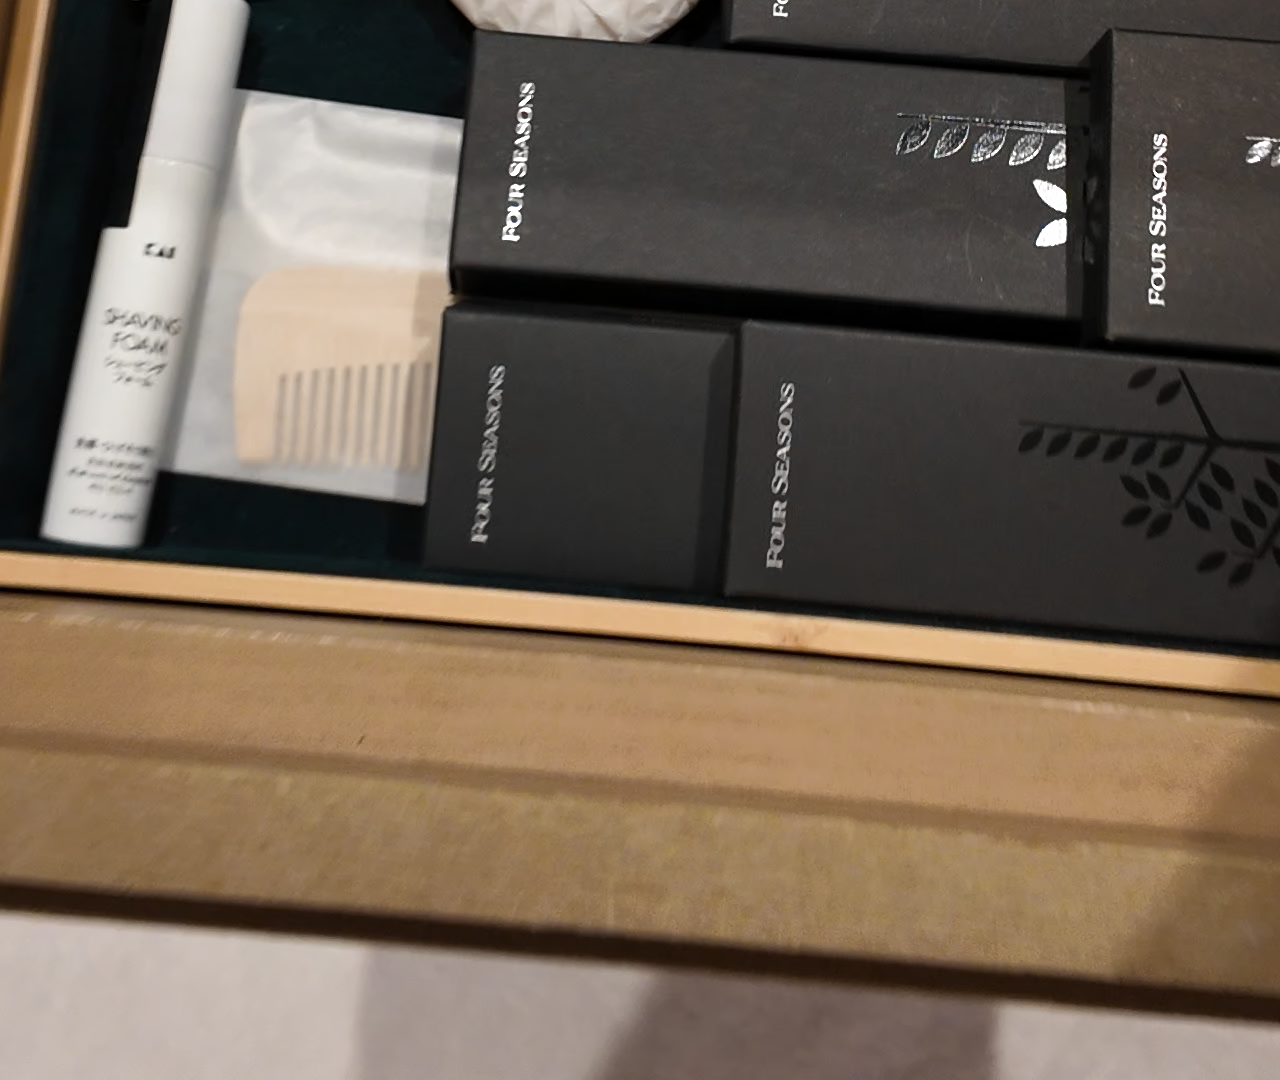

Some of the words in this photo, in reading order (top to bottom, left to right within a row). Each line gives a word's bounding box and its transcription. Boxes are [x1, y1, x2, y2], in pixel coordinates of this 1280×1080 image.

[508, 82, 536, 178] SEASONS
[501, 183, 524, 243] FOUR
[1149, 133, 1168, 237] SEASONS
[1148, 243, 1166, 306] FOUR
[103, 307, 183, 336] SHAVING
[110, 331, 170, 354] FOAM
[477, 365, 506, 473] SEASONS
[771, 382, 795, 496] SEASONS
[470, 477, 494, 544] FOUR
[766, 502, 787, 569] FOUR
